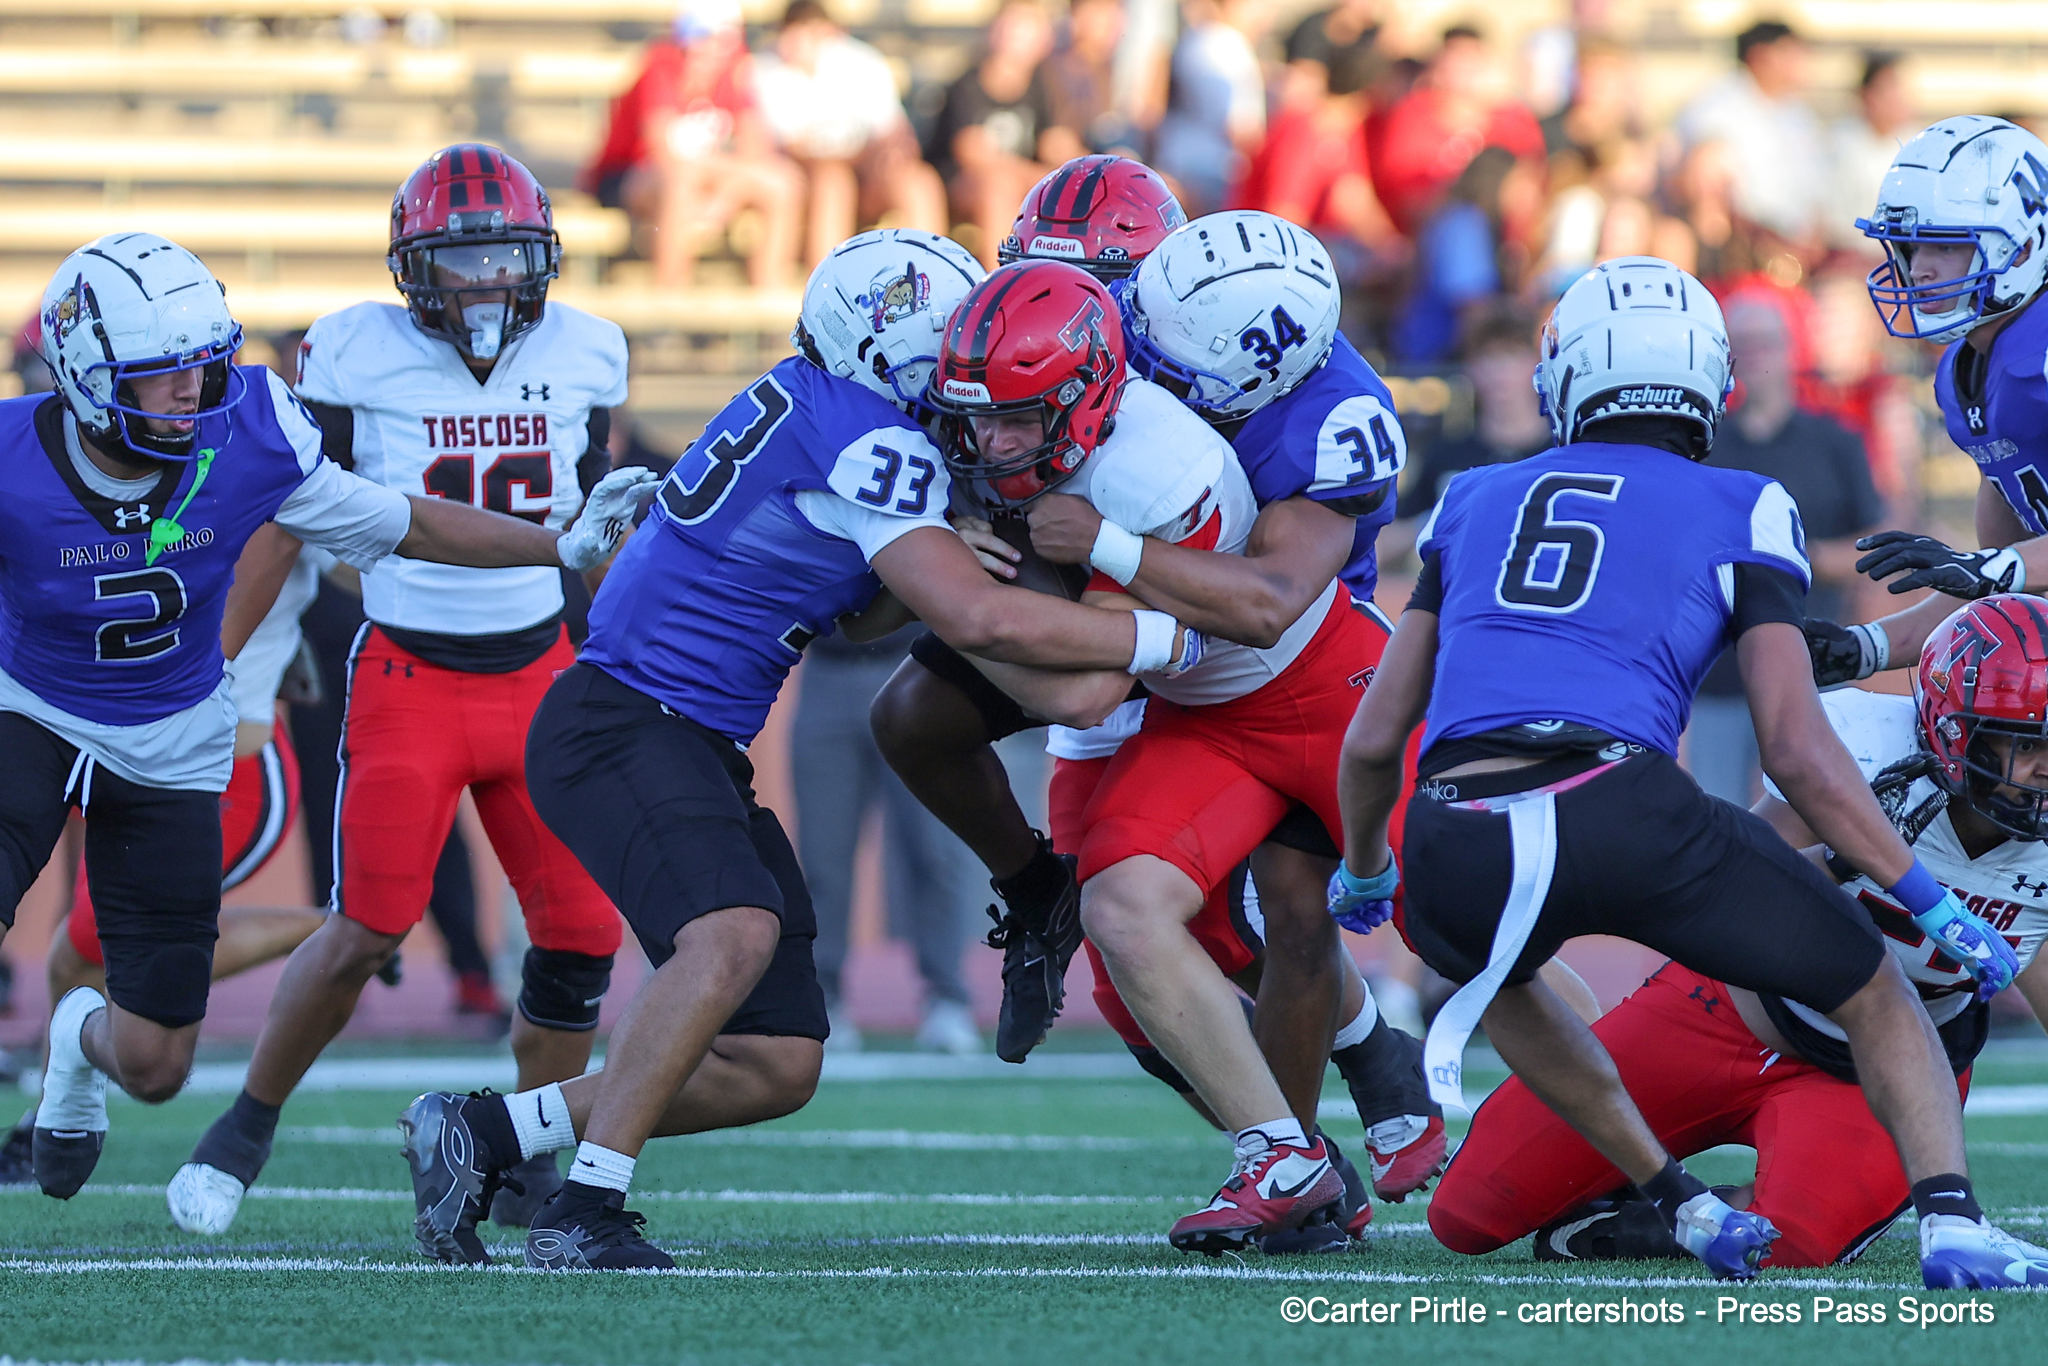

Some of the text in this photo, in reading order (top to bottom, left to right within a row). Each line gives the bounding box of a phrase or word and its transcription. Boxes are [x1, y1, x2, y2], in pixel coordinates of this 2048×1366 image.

[1035, 239, 1076, 252] Riddell
[1240, 304, 1308, 370] 34
[946, 384, 980, 397] Riddell
[423, 414, 547, 448] TASCOSA
[1334, 413, 1399, 484] 34
[856, 443, 936, 515] 33
[60, 541, 130, 567] PALO
[1495, 471, 1626, 614] 6
[94, 566, 188, 663] 2
[1420, 780, 1458, 801] thika
